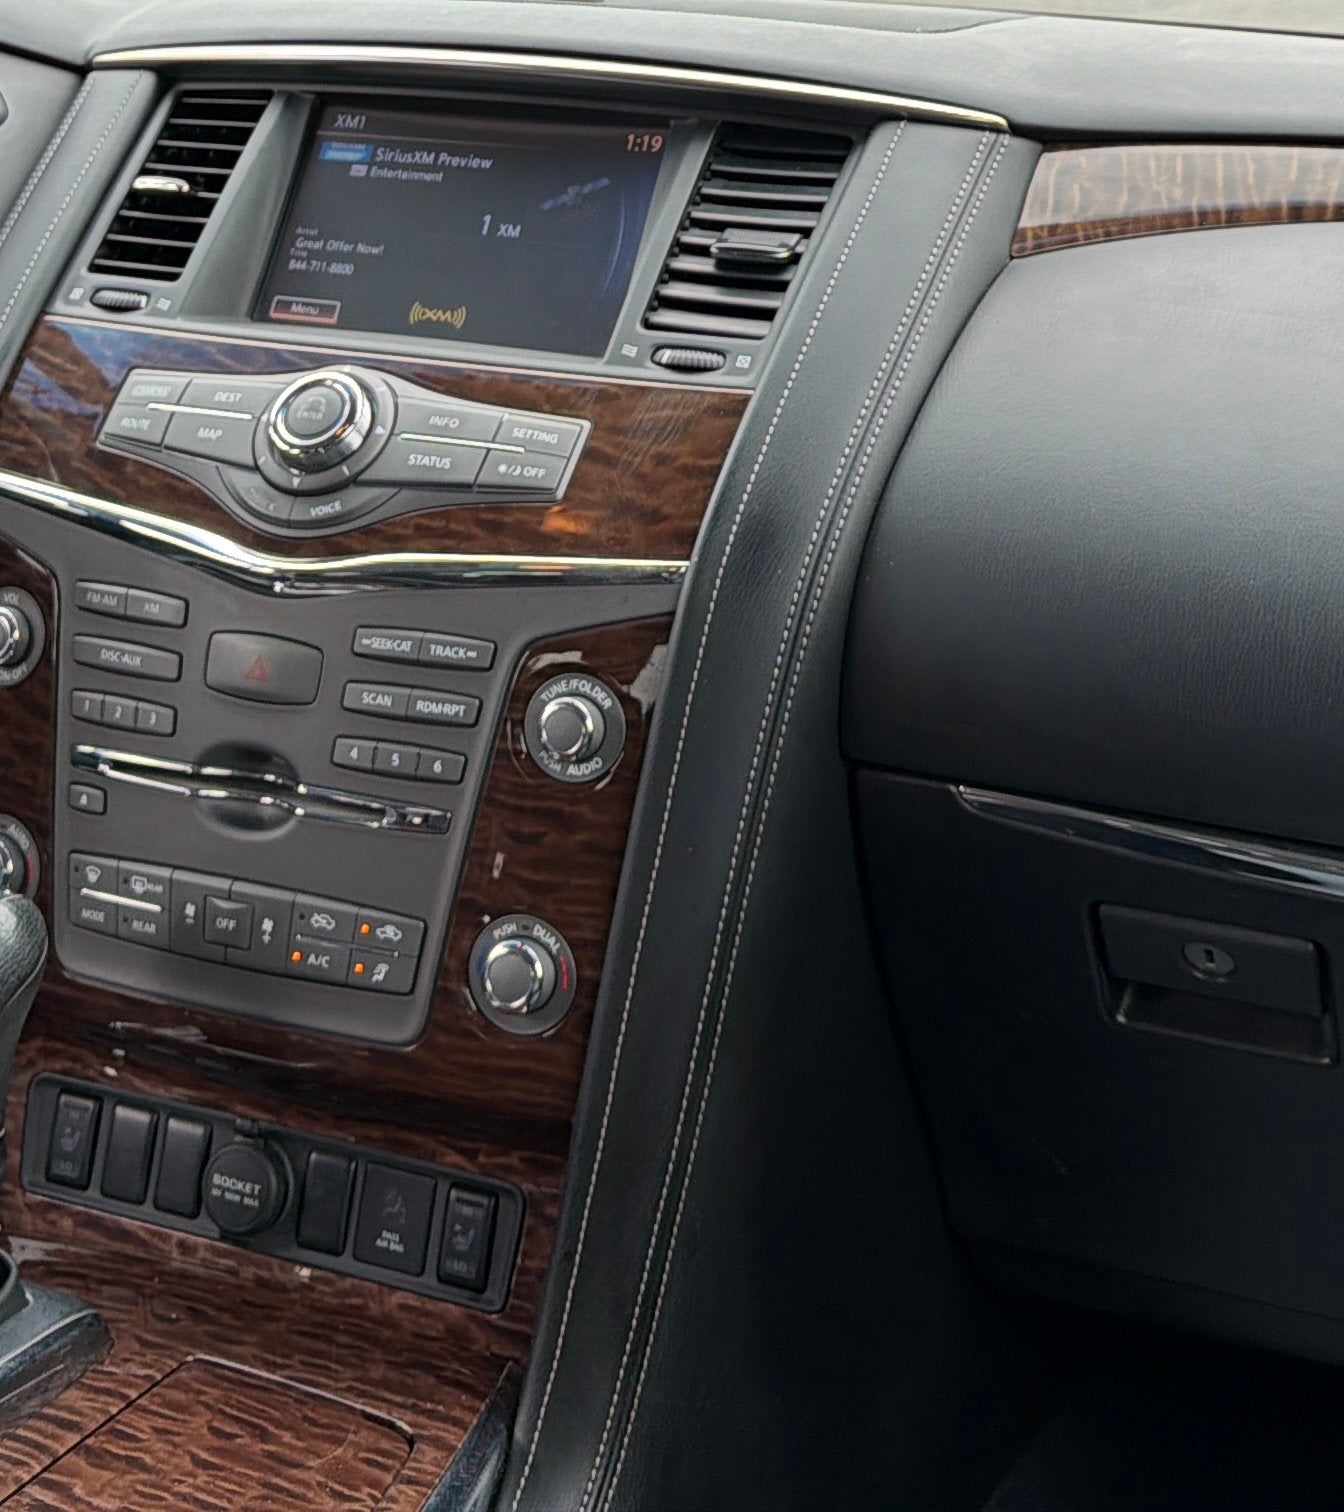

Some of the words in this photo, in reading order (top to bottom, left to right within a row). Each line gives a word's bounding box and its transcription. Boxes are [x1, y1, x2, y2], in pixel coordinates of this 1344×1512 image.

[334, 114, 367, 129] XM1
[626, 133, 664, 154] 1:19
[374, 147, 435, 165] SiriusXM
[437, 152, 494, 169] Preview
[369, 165, 444, 182] Entertainment
[481, 214, 492, 236] 1
[497, 223, 522, 238] XM
[295, 237, 324, 251] Great
[327, 239, 355, 253] Offer
[356, 242, 385, 256] Now!
[290, 302, 320, 315] Menu
[213, 391, 243, 403] DEST
[429, 415, 460, 428] INFO
[512, 427, 559, 444] SETTING
[408, 453, 453, 470] STATUS
[523, 464, 547, 479] OFF
[310, 501, 342, 518] VOICE
[429, 644, 467, 659] TRACK
[362, 691, 393, 707] SCAN
[540, 678, 613, 709] TUNE/FOLDER
[349, 746, 358, 760] 4
[391, 753, 400, 766] 5
[433, 760, 442, 773] 6
[566, 756, 603, 776] AUDIO
[132, 919, 157, 933] REAR
[215, 917, 238, 931] OFF
[493, 922, 518, 940] PUSH
[532, 924, 561, 955] DUAL
[307, 953, 330, 969] A/C
[212, 1173, 262, 1196] SOCKET
